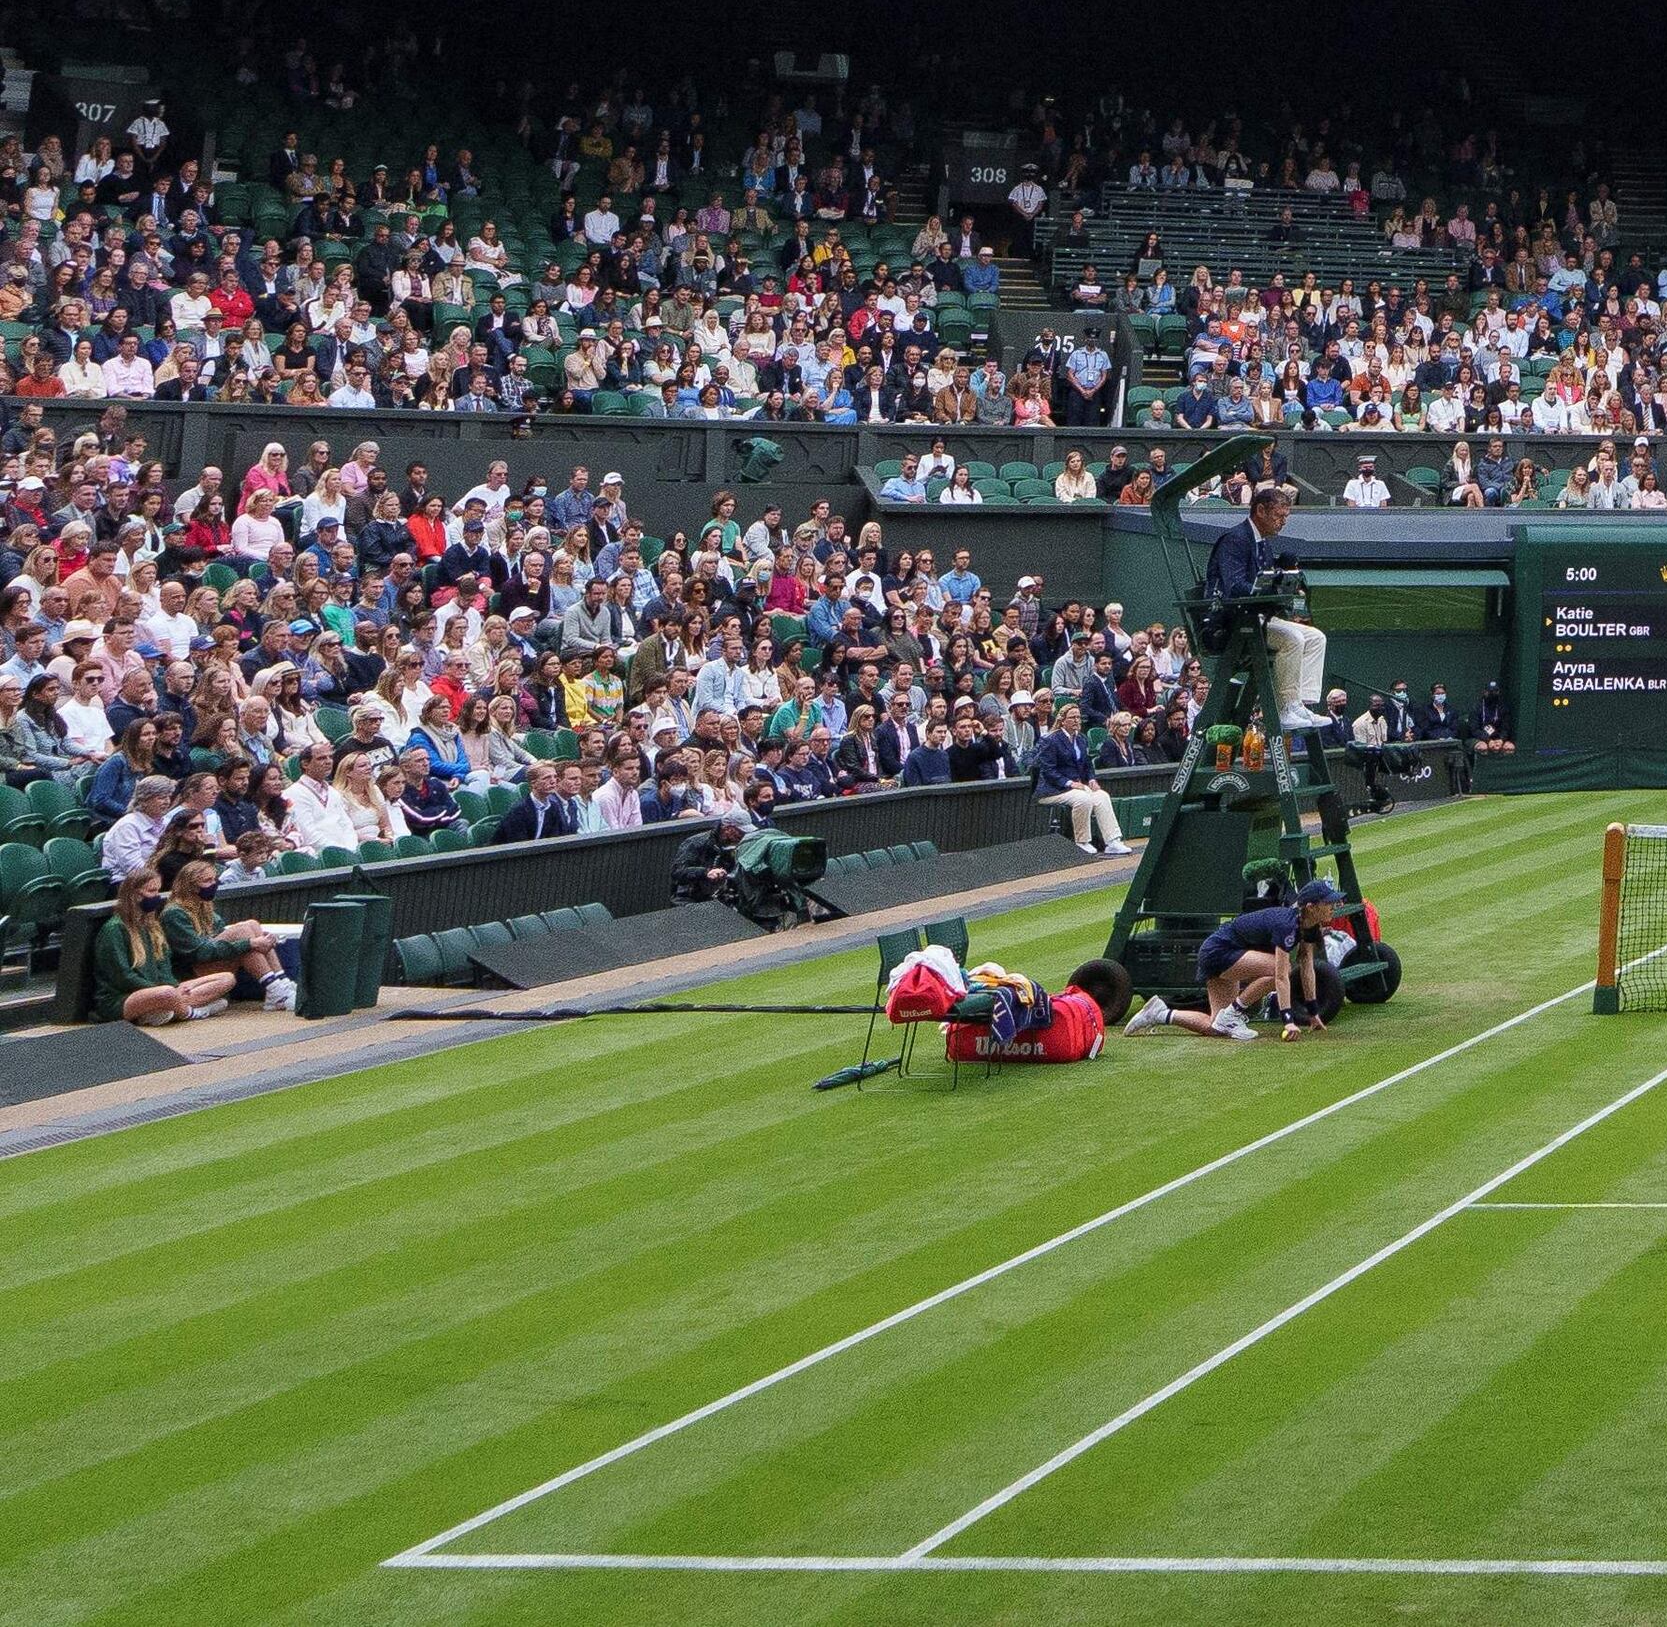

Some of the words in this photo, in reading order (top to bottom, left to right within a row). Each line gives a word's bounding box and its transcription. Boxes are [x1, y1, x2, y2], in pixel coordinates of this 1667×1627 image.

[970, 166, 1007, 183] 308
[1565, 567, 1598, 581] 5:00
[1556, 607, 1594, 620] Katie
[1555, 624, 1627, 637] BOULTER
[1629, 626, 1650, 636] GBR
[1553, 661, 1596, 677] Aryna
[1552, 677, 1645, 692] SABALENKA
[1648, 679, 1667, 690] BLR
[1171, 735, 1201, 793] Slazenger
[1273, 735, 1290, 793] Slazenger
[900, 1008, 932, 1018] Wilson
